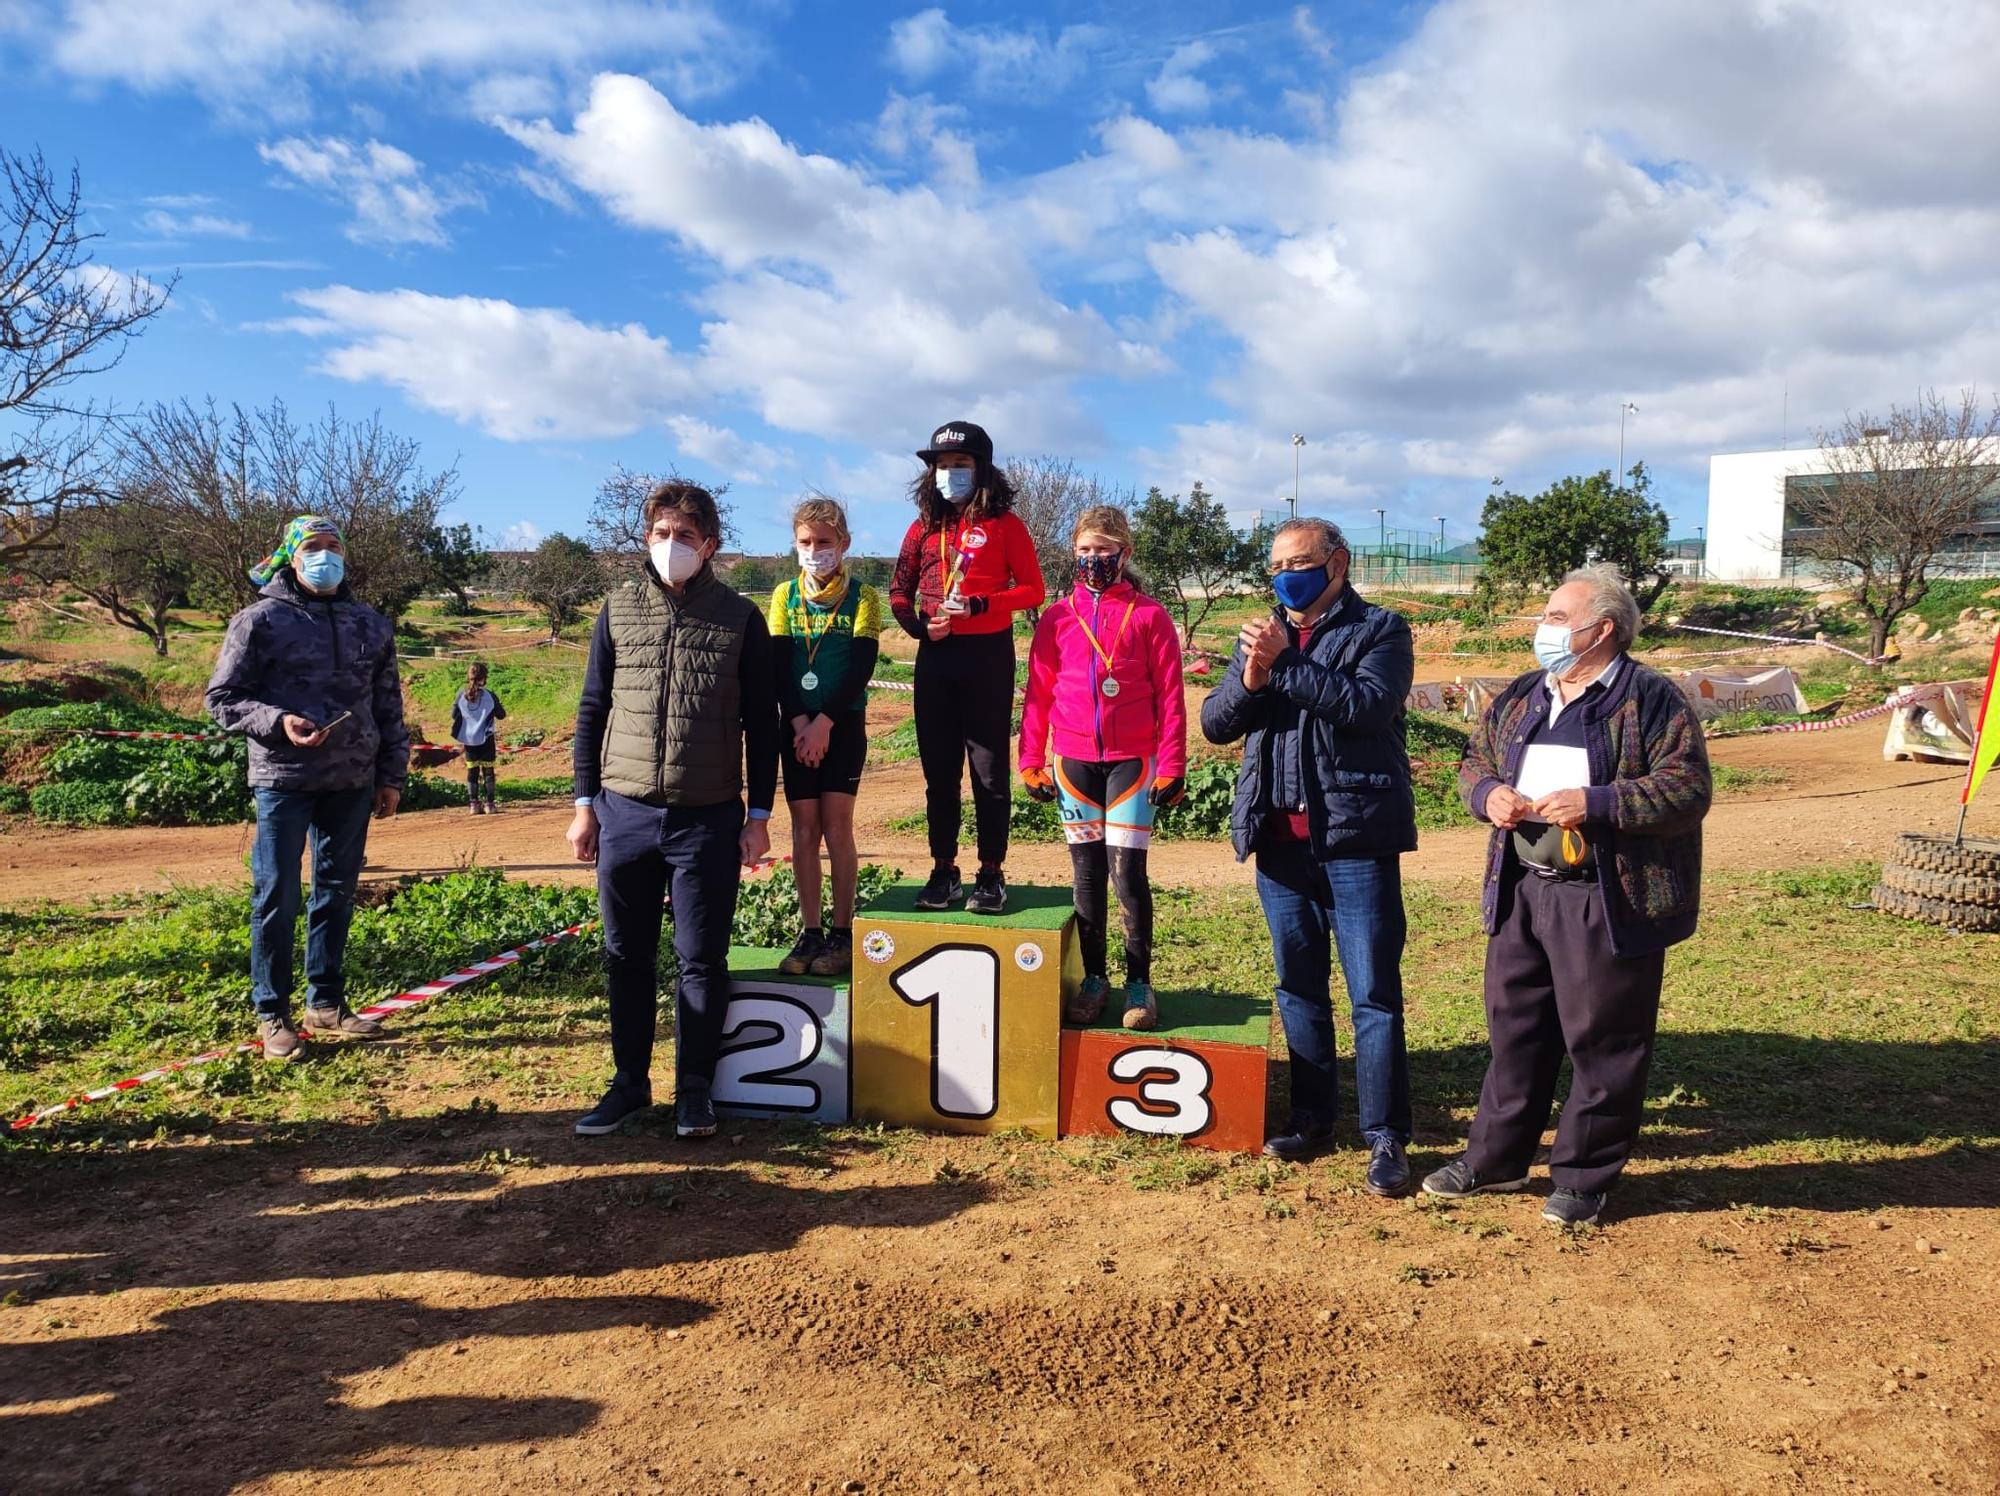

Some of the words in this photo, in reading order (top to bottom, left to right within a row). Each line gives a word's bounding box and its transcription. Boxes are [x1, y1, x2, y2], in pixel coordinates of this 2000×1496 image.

[711, 992, 822, 1113] 2
[890, 942, 1000, 1120] 1
[1106, 1045, 1213, 1139] 3
